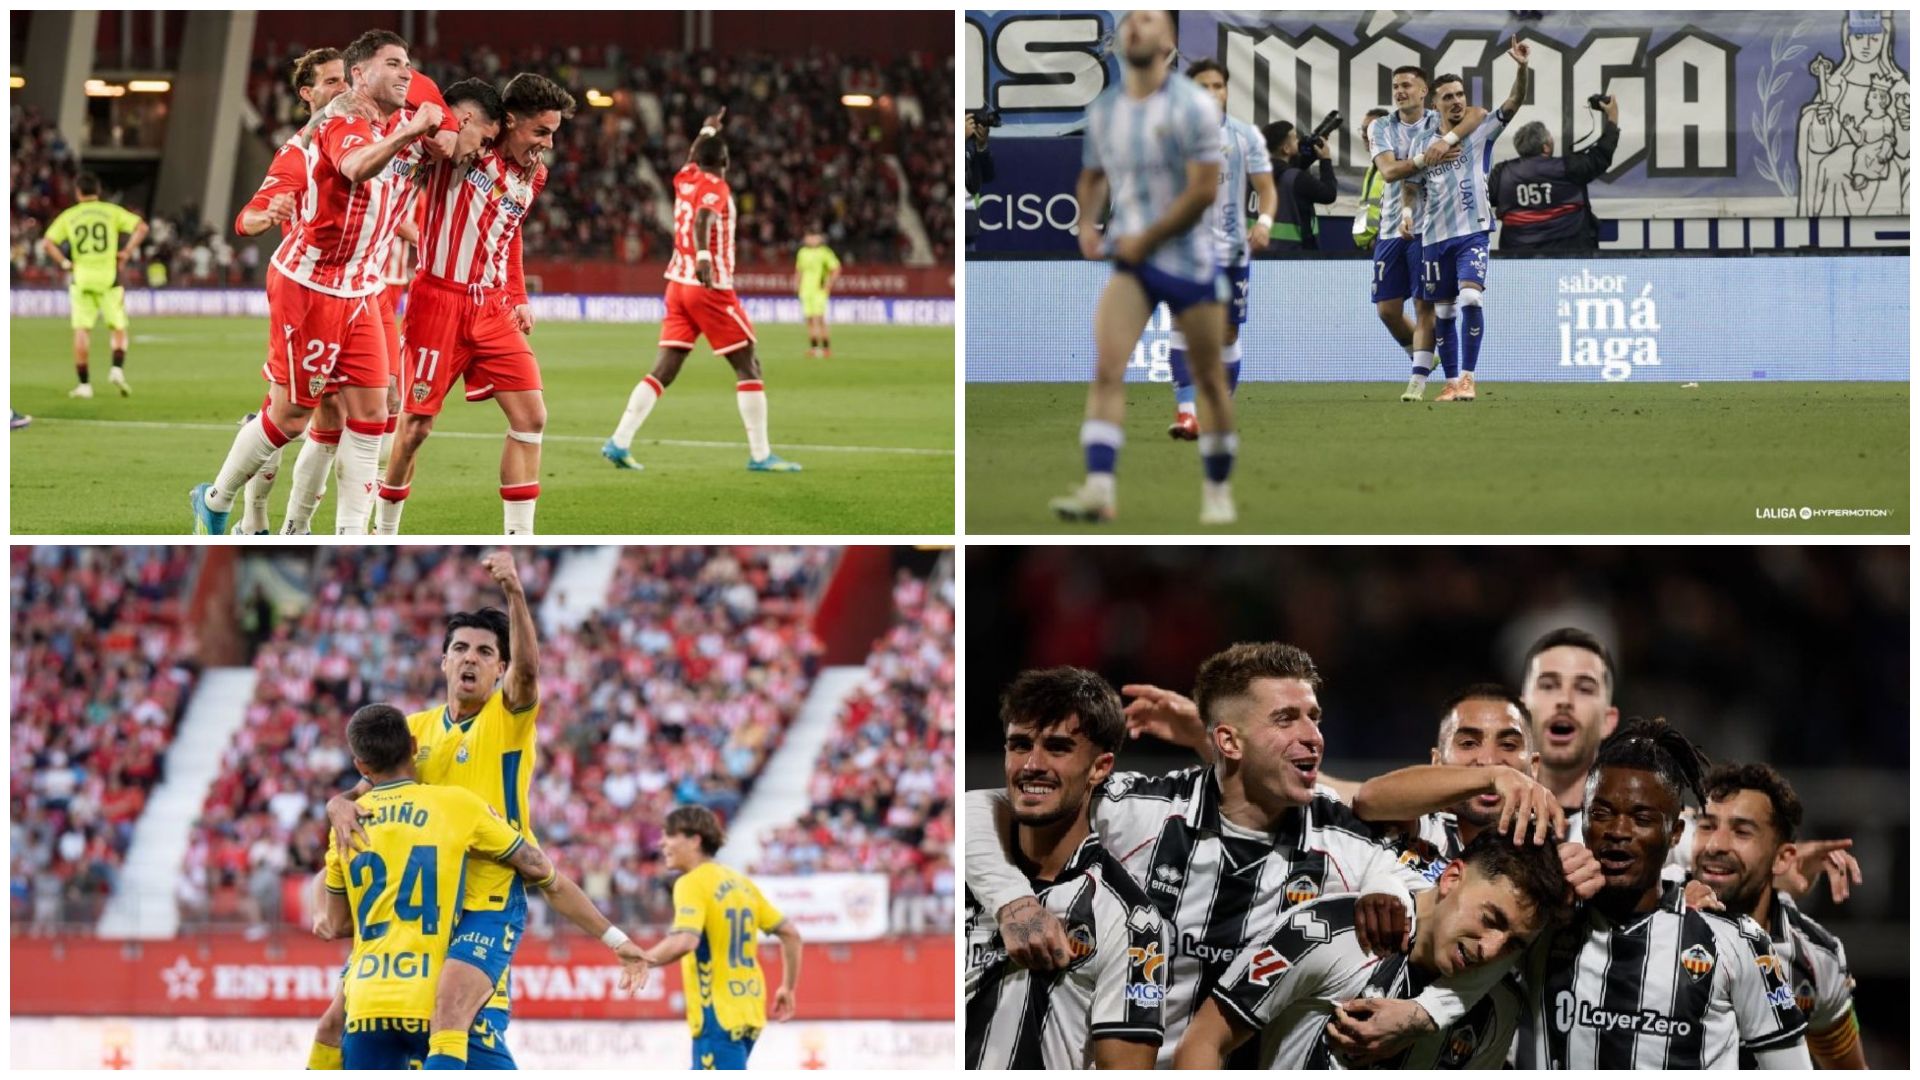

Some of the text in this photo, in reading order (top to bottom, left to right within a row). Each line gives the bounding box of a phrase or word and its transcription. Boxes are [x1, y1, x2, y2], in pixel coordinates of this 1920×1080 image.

[465, 166, 494, 193] KUDU
[1459, 178, 1475, 212] UAX
[1516, 182, 1552, 207] 057
[74, 221, 108, 255] 29
[1424, 260, 1441, 281] 11
[1558, 267, 1627, 294] sabor
[1558, 281, 1662, 331] a má
[302, 338, 341, 375] 23
[415, 346, 440, 381] 11
[1558, 321, 1662, 382] laga
[349, 845, 440, 942] 24
[356, 951, 430, 980] DIGI
[1125, 984, 1164, 1000] MGS
[1580, 1003, 1691, 1037] LayerZero
